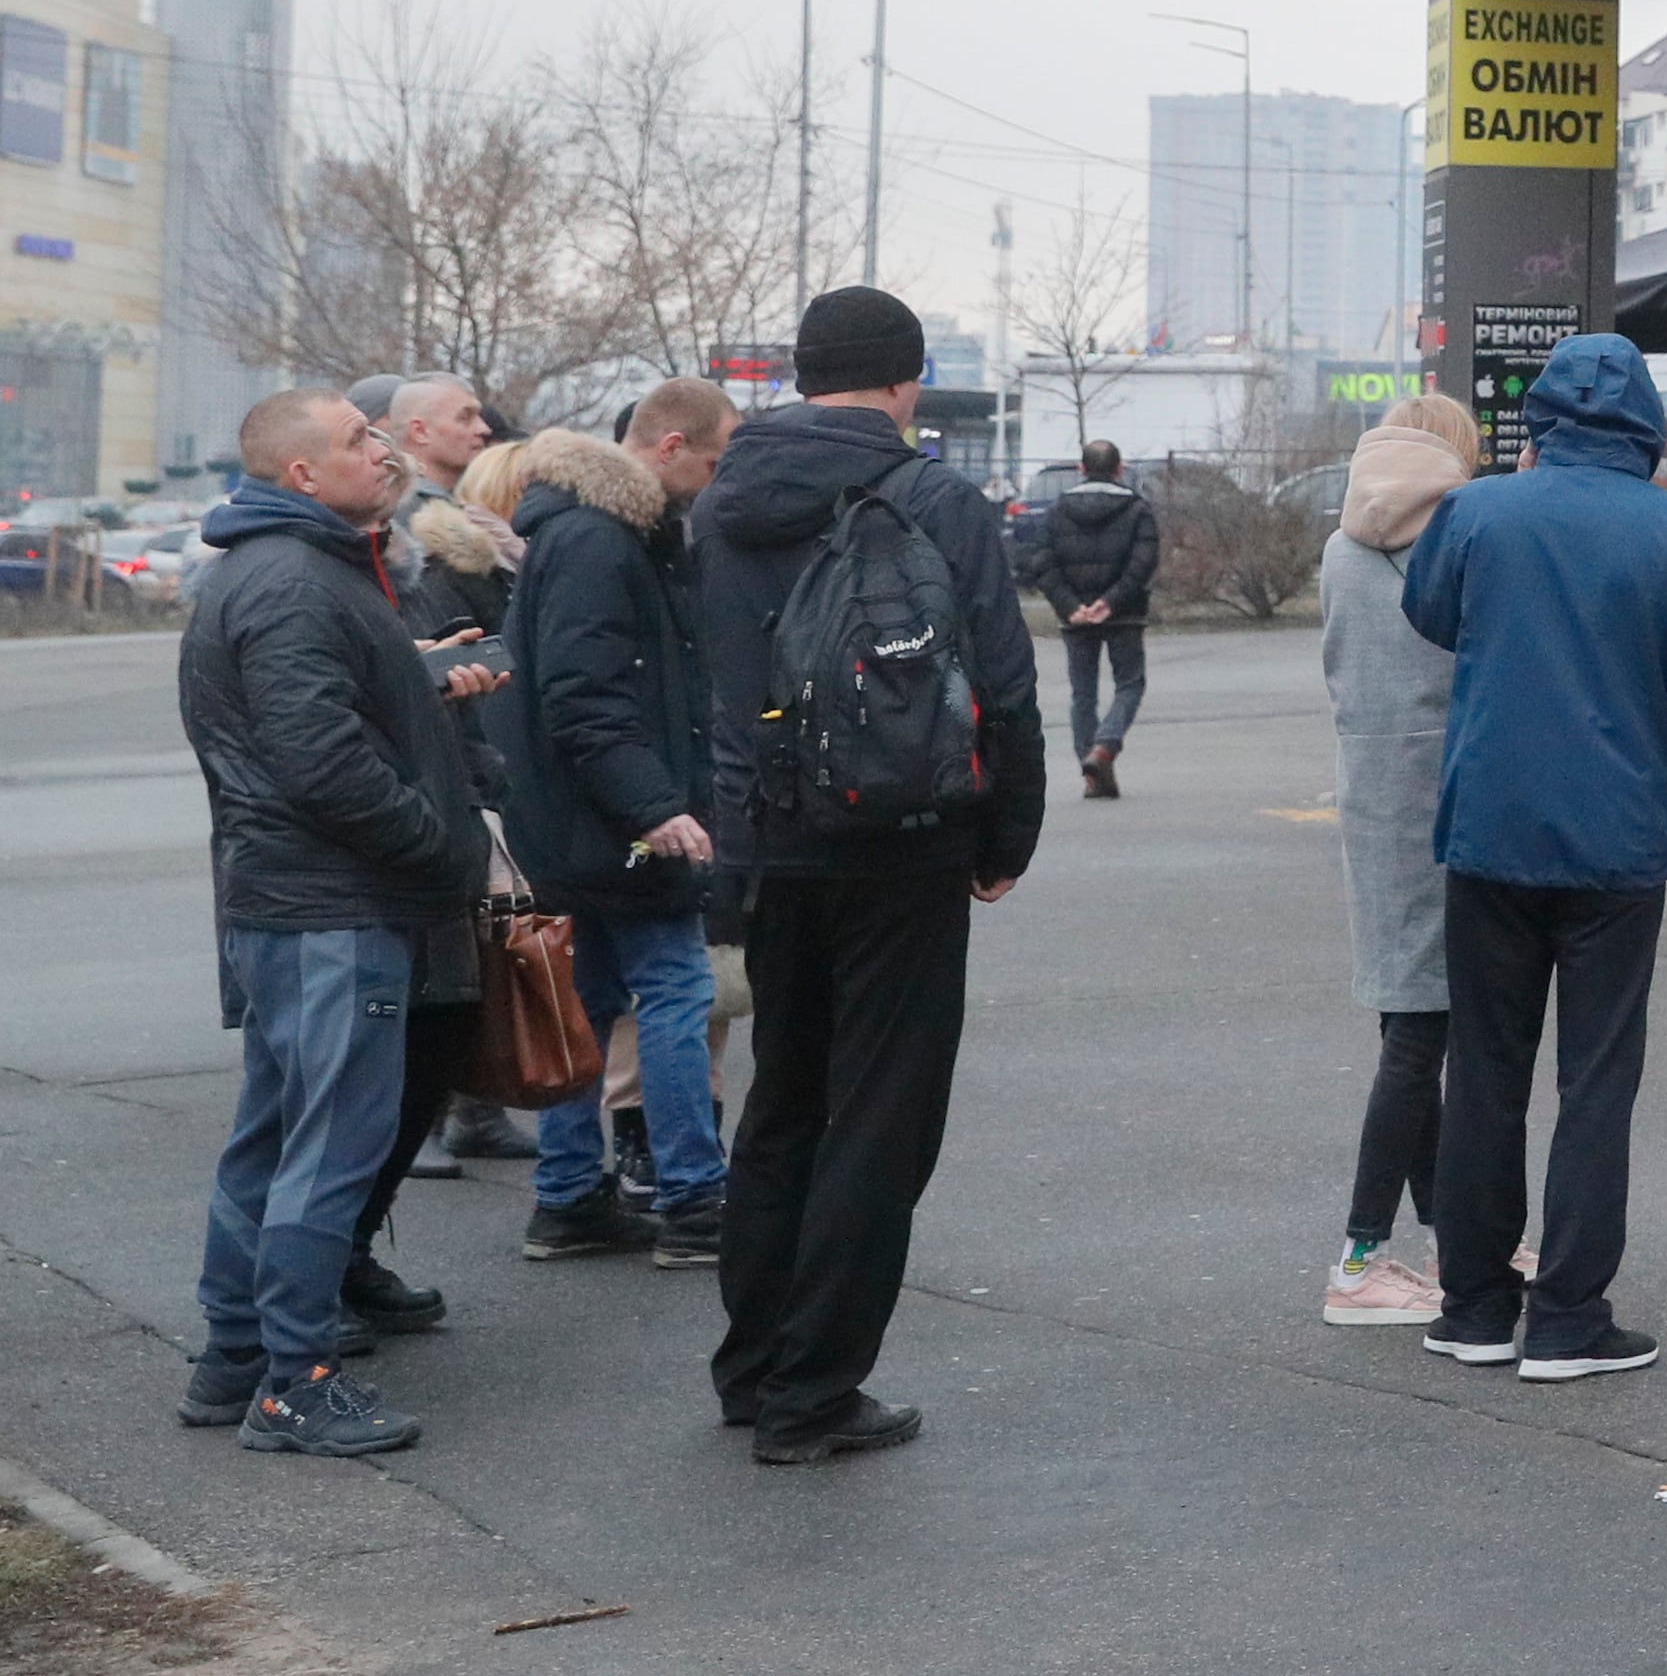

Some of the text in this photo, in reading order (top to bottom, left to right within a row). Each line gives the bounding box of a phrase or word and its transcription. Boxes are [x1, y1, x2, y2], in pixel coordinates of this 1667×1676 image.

[1465, 9, 1604, 45] EXCHANGE
[1471, 58, 1597, 96] ОБМІН
[1463, 107, 1603, 144] ВАЛЮТ
[1475, 305, 1578, 321] ТЕРМІНОВИЙ
